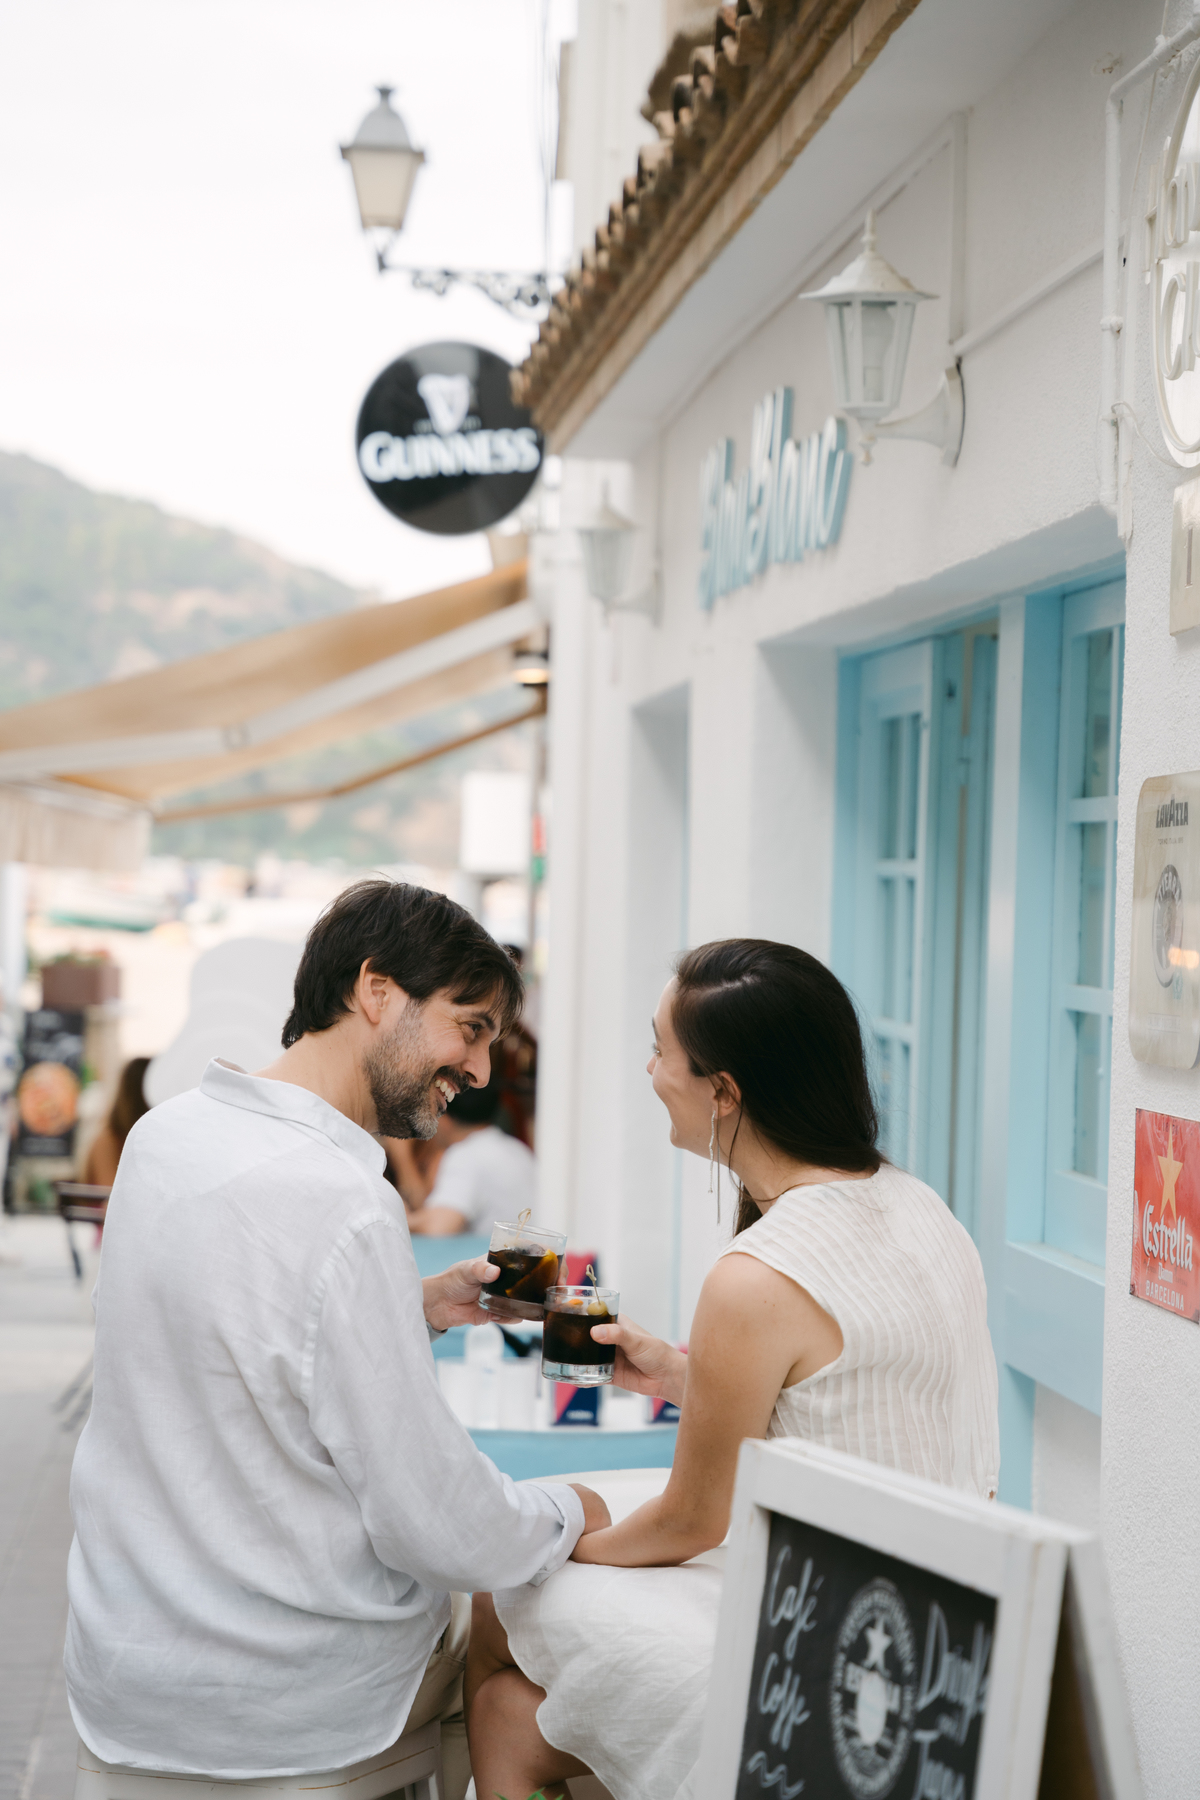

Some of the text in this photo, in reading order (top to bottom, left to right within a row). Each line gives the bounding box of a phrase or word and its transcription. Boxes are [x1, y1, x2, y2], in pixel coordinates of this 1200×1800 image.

[1156, 796, 1189, 829] LAVAZZA
[1142, 1199, 1193, 1272] Estrella
[1146, 1280, 1185, 1311] BARCELONA
[767, 1544, 825, 1661] Café
